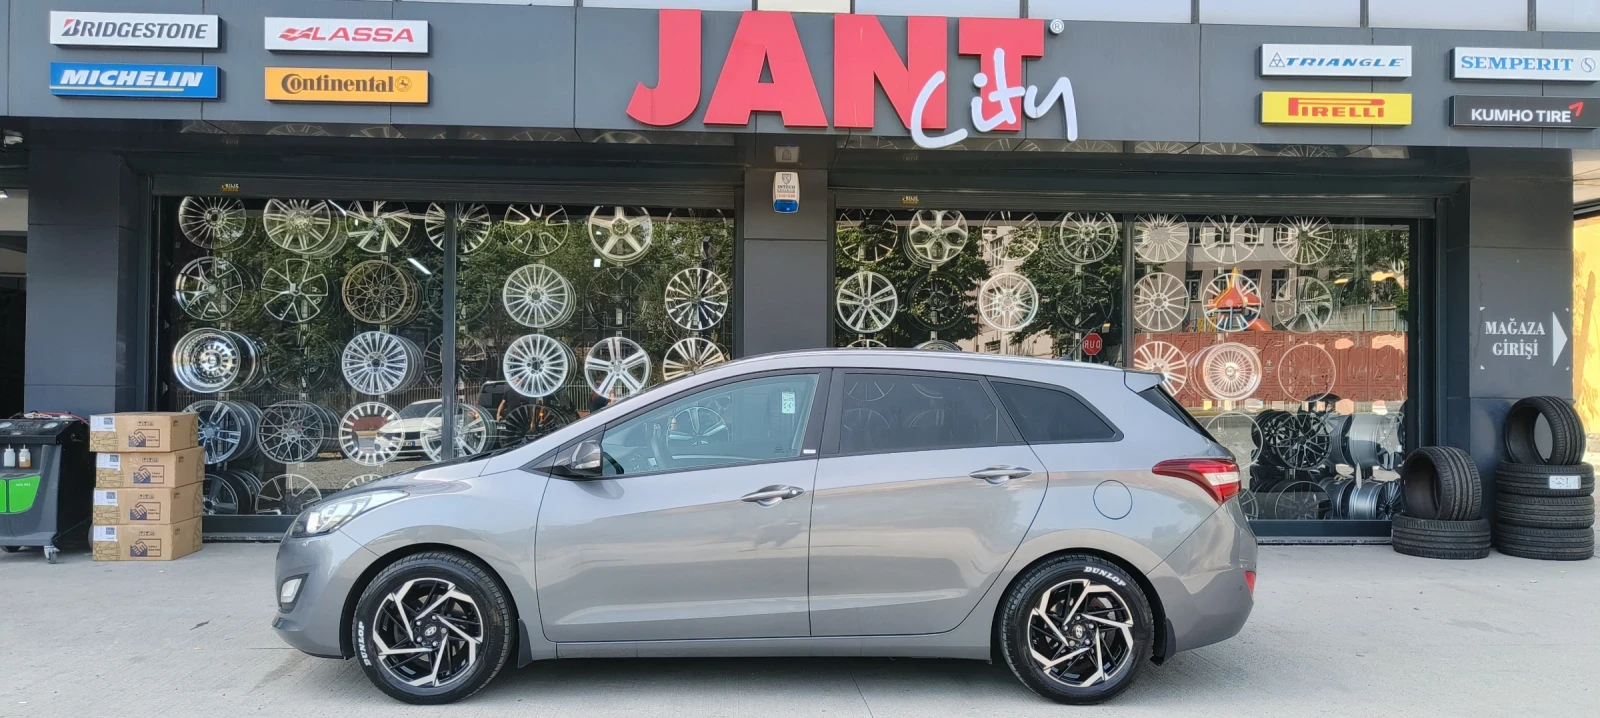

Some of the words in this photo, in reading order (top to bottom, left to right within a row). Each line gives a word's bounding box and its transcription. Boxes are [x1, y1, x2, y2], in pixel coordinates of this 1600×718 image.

[61, 19, 208, 39] BRIDGESTONE
[311, 26, 414, 43] LASSA
[626, 8, 1044, 131] JANT
[1286, 57, 1405, 67] TRIANGLE
[1461, 55, 1573, 71] SEMPERIT
[60, 69, 203, 87] MICHELIN
[281, 73, 394, 94] Continental
[911, 47, 1078, 149] City
[1288, 97, 1386, 118] PIRELLI
[1471, 108, 1534, 122] KUMHO
[1536, 110, 1571, 123] TIRE
[1485, 317, 1546, 335] MAĞAZA
[1492, 338, 1539, 360] GİRİŞİ
[1083, 566, 1127, 587] DUNLOP
[357, 621, 372, 666] DUNLOP
